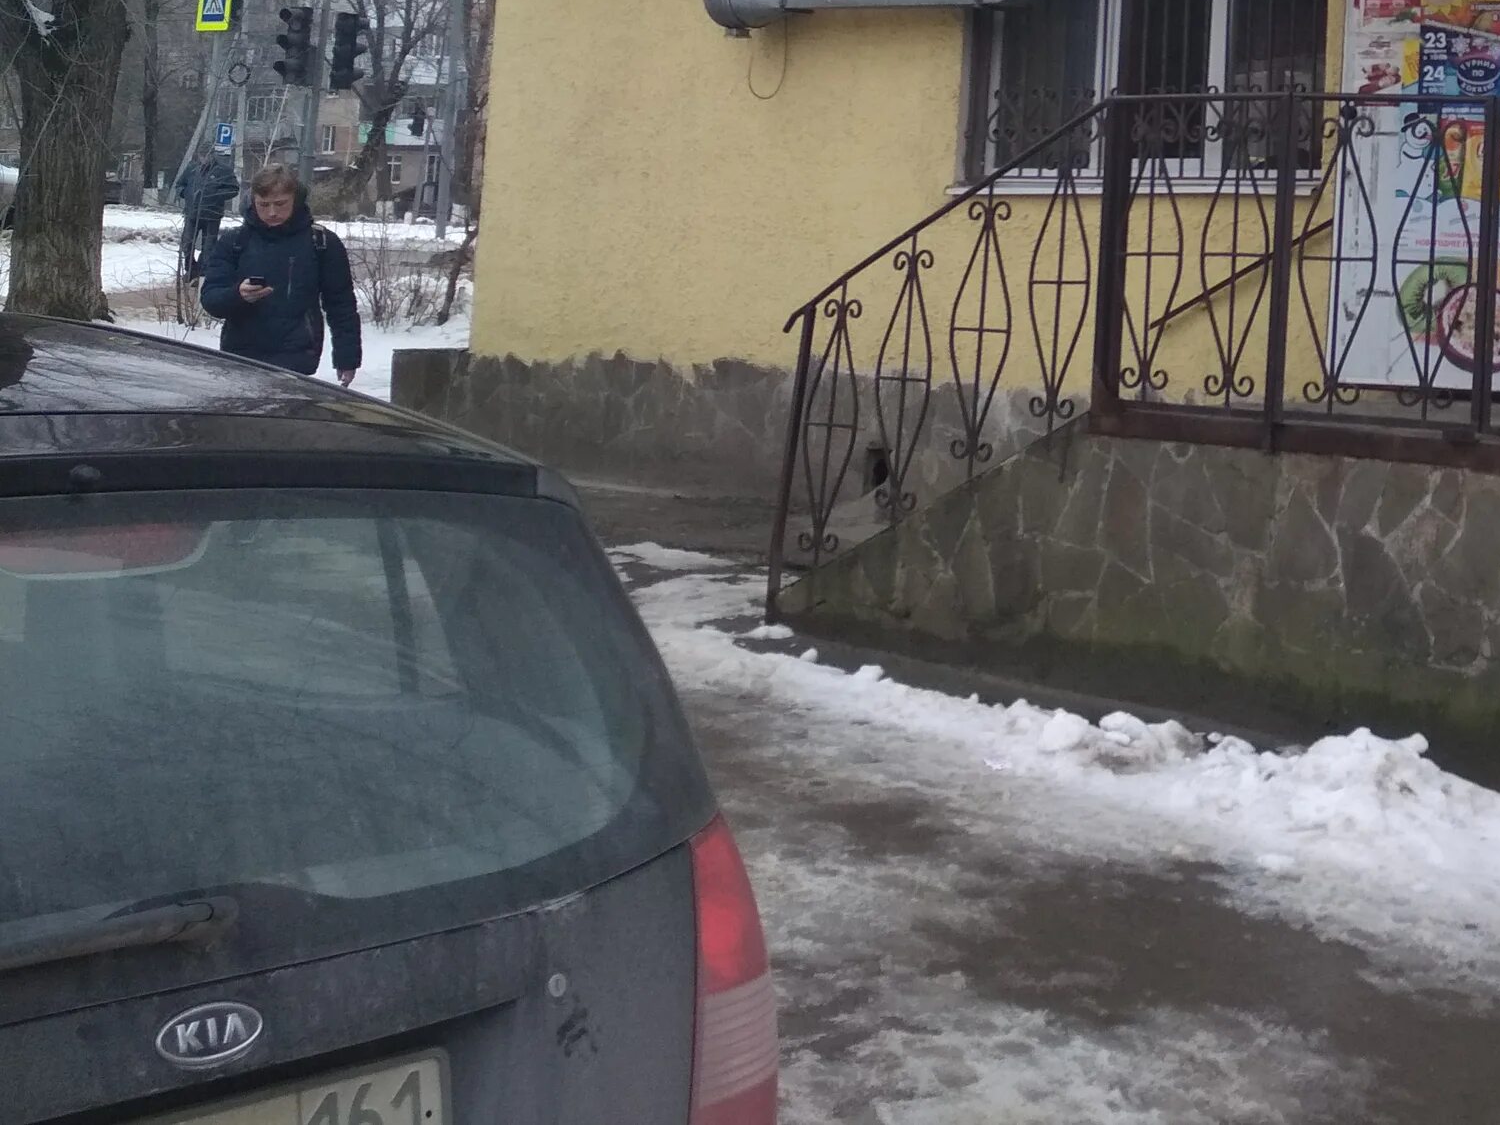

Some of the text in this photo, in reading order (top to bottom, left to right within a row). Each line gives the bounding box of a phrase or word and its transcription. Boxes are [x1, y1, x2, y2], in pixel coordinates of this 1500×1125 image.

[1424, 32, 1447, 48] 23
[1423, 65, 1445, 81] 24
[1460, 59, 1496, 71] ТУРНИР
[174, 1012, 248, 1054] KIA
